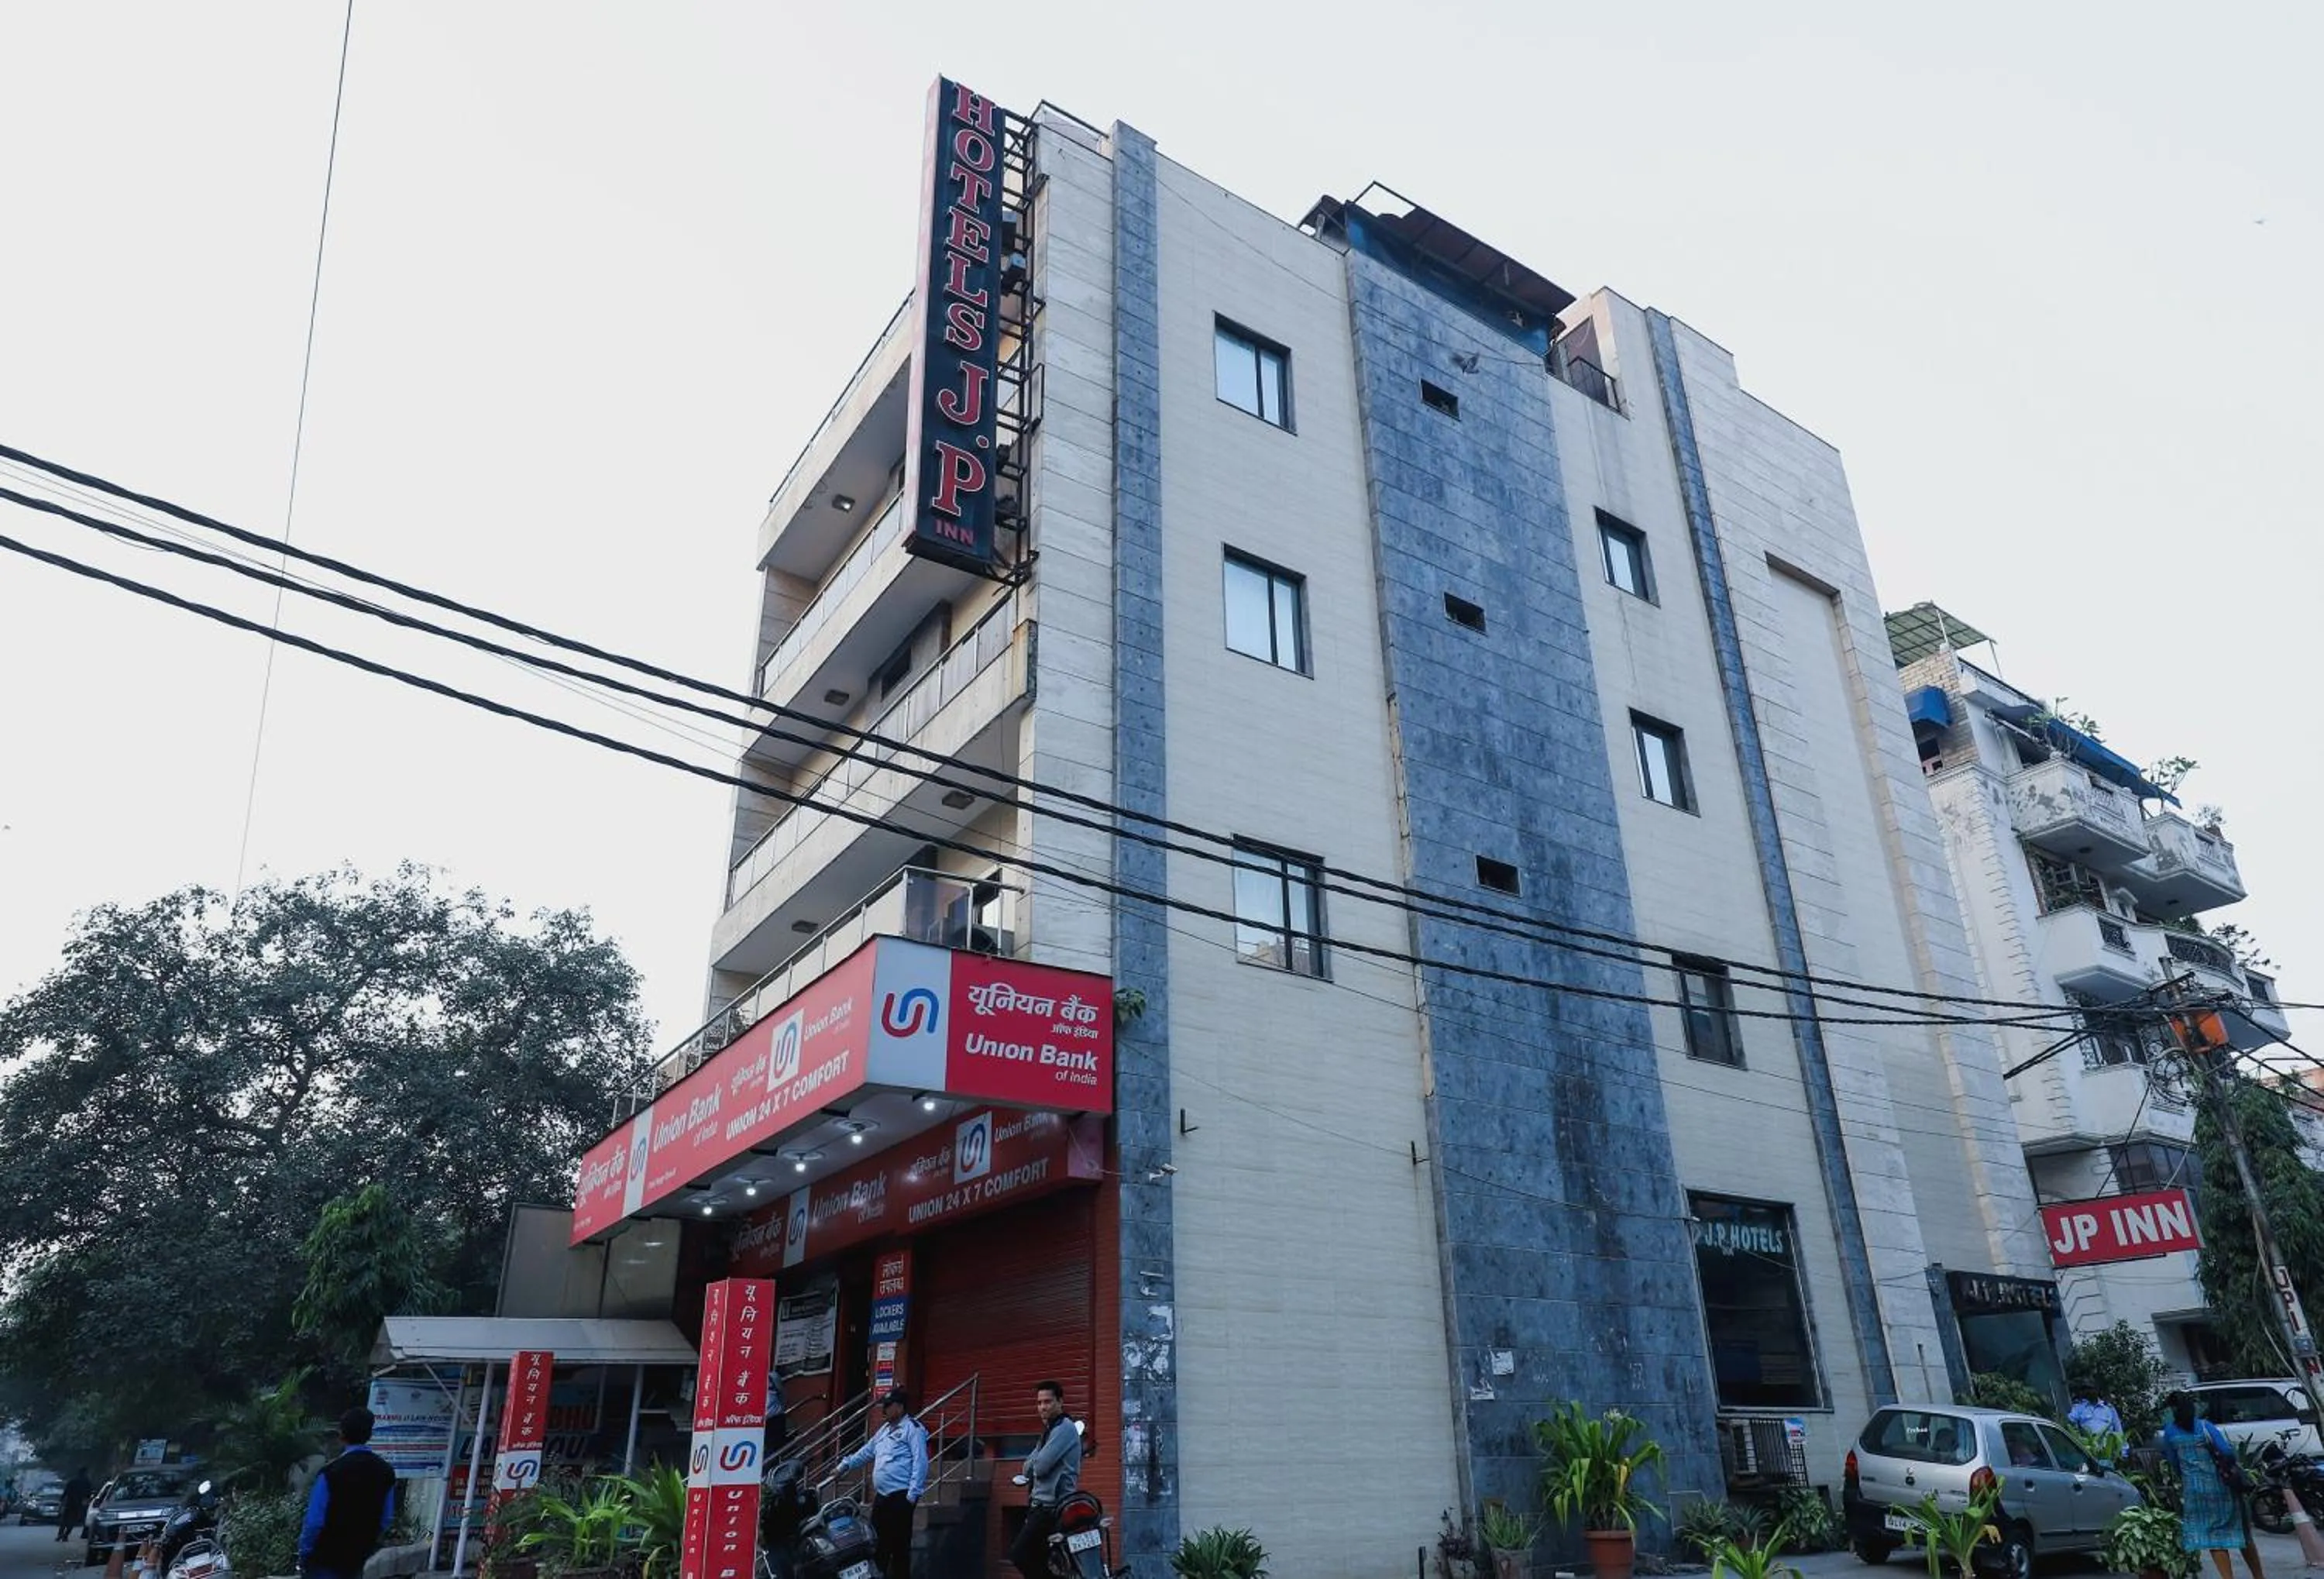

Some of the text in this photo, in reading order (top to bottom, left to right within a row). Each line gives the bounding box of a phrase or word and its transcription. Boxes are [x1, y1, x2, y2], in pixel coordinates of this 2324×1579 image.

[944, 81, 995, 351] HOTELS
[934, 518, 974, 547] INN
[968, 982, 1099, 1023] यूनियन बैंक
[965, 1033, 1098, 1071] Union Bank
[725, 1106, 758, 1141] UNION
[758, 1097, 771, 1121] 24
[782, 1086, 789, 1108] 7
[792, 1049, 850, 1101] COMFORT
[1055, 1070, 1069, 1082] of
[653, 1083, 722, 1152] Union Bank
[812, 1171, 887, 1227] Union Bank
[909, 1157, 1050, 1223] UNION 24 X 7 COMFORT
[1730, 1223, 1783, 1254] HOTELS
[2054, 1200, 2192, 1254] JP INN
[740, 1285, 757, 1358] यूनियन
[871, 1318, 906, 1336] AVAILABLE
[875, 1302, 905, 1319] LOCKERS
[735, 1370, 751, 1406] बैंक
[722, 1490, 744, 1552] Union
